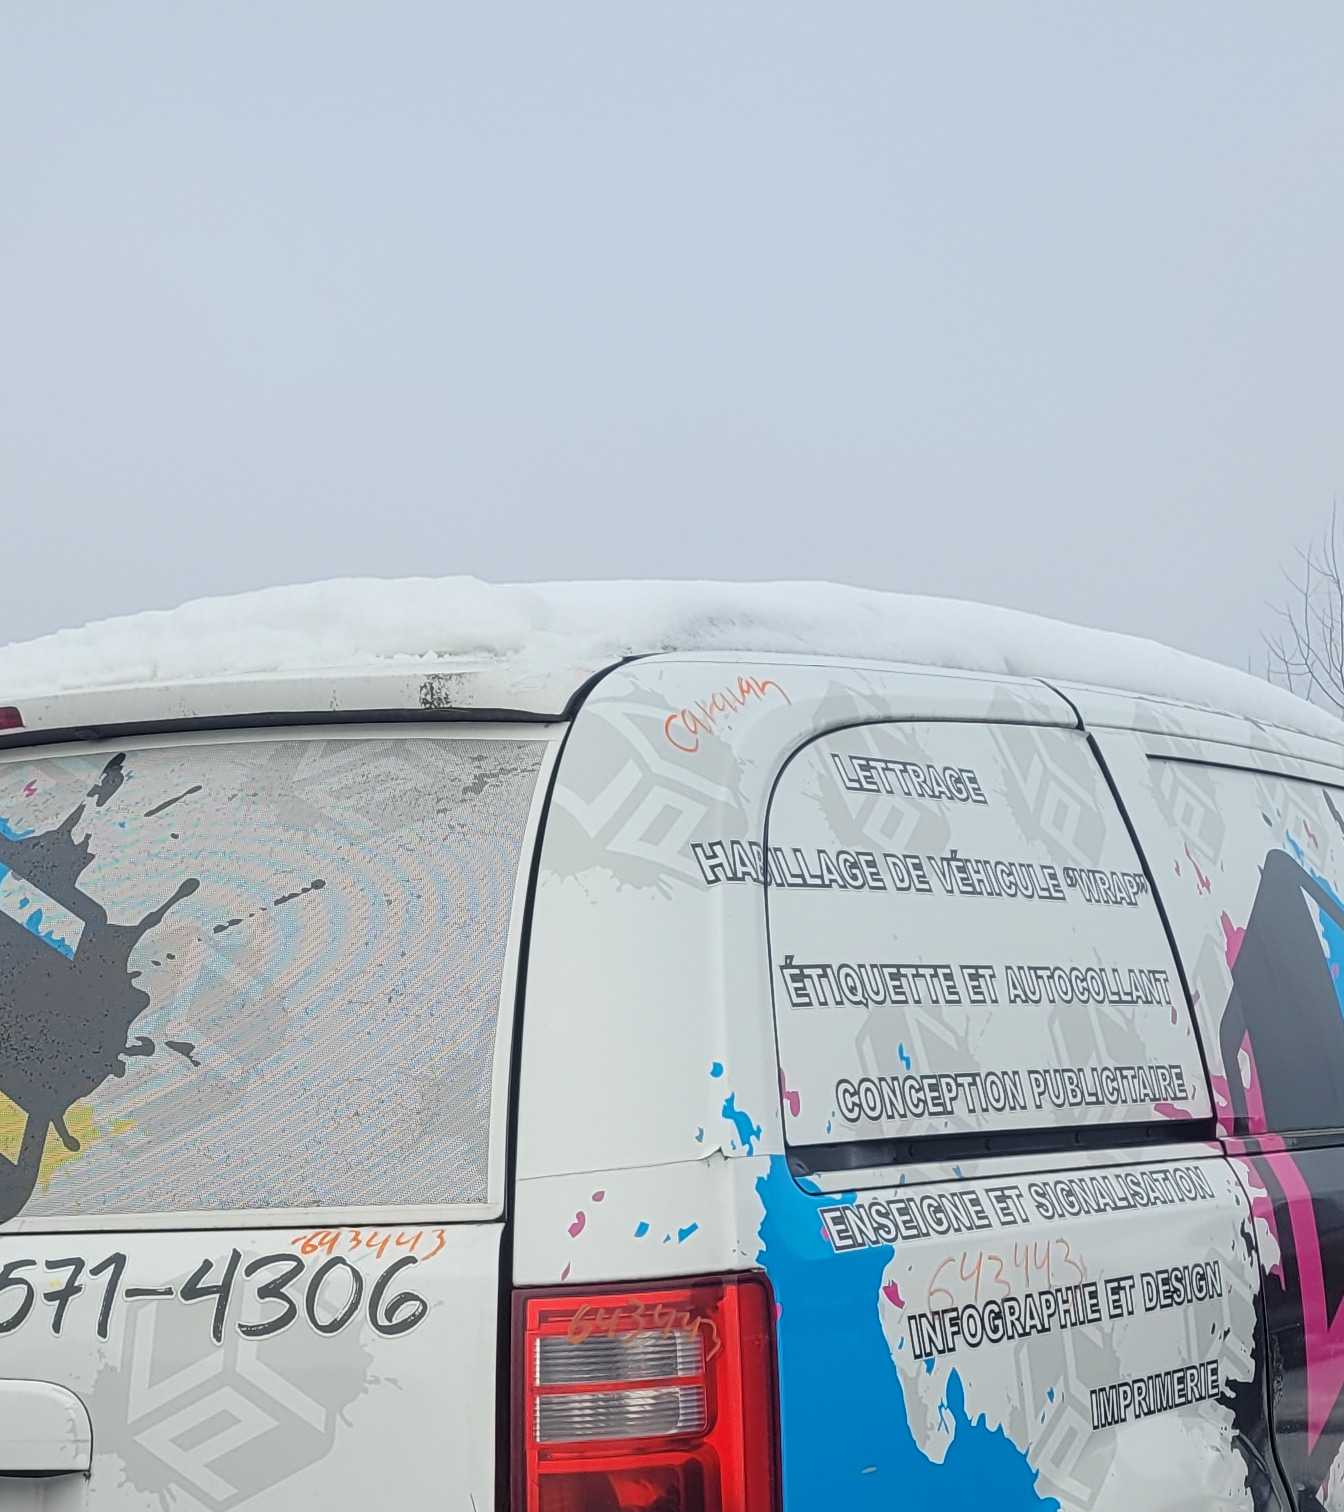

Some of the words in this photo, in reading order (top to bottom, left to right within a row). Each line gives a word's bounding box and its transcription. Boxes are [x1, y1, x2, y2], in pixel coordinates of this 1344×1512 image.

[831, 753, 988, 805] LETTRAGE
[883, 853, 933, 893] DE
[927, 849, 1066, 900] VÉHICULE
[779, 955, 961, 1008] ÉTIQUETTE
[959, 964, 999, 1004] ET
[1005, 965, 1174, 1005] AUTOCOLLANT
[835, 1070, 1028, 1123] CONCEPTION
[1029, 1064, 1189, 1110] PUBLICITAIRE
[818, 1193, 992, 1252] ENSEIGNE
[990, 1185, 1029, 1227] ET
[1027, 1166, 1215, 1219] SIGNALISATION
[907, 1281, 1101, 1360] INFOGRAPHIE
[1104, 1275, 1135, 1318] ET
[1140, 1261, 1223, 1313] DESIGN
[1090, 1360, 1221, 1430] IMPRIMERIE
